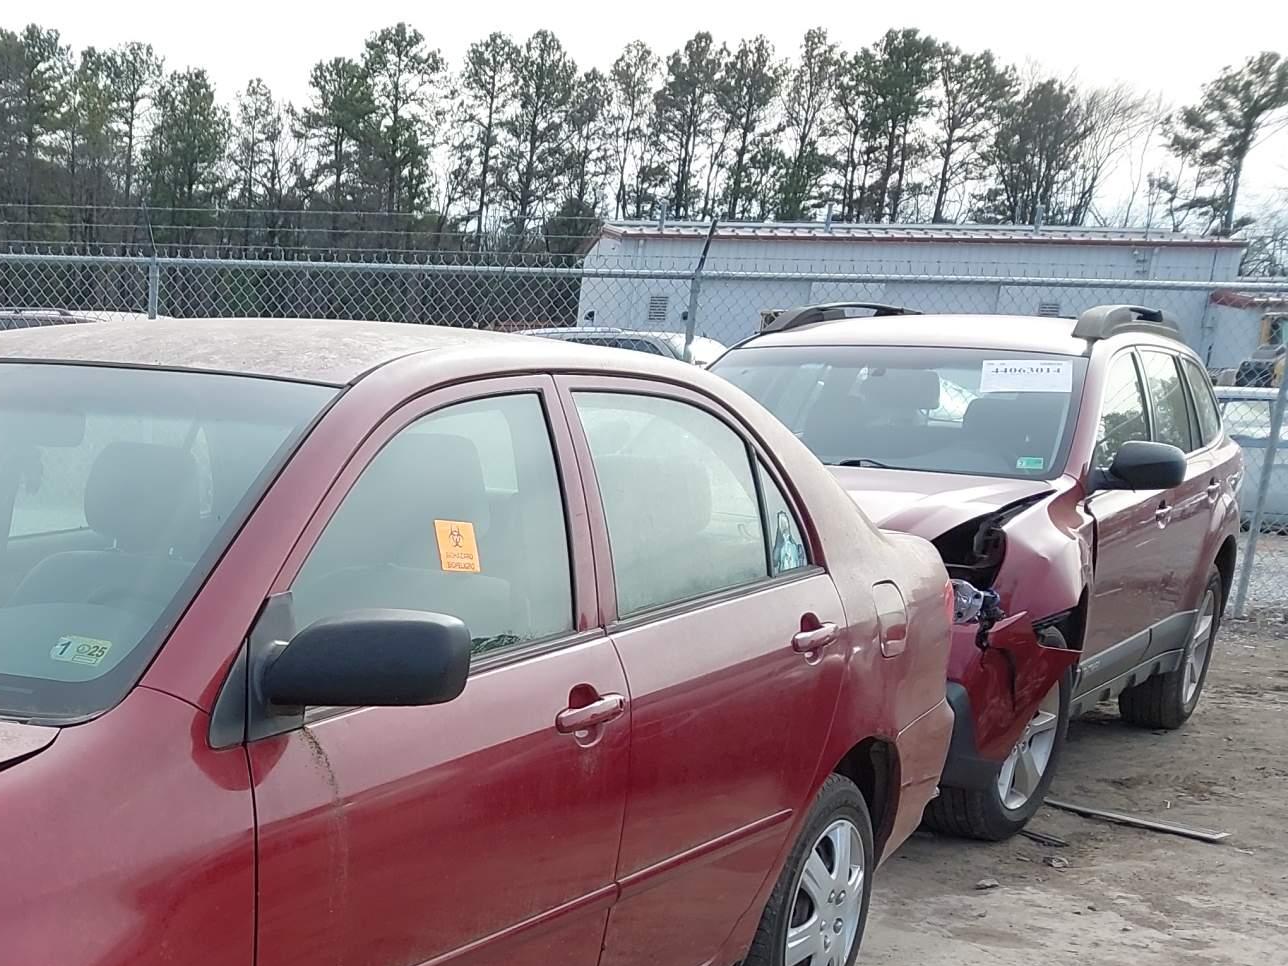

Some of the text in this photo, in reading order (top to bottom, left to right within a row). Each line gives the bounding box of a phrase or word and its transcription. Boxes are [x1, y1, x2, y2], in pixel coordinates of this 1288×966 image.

[991, 366, 1061, 374] 44063014
[58, 640, 108, 658] 1 25
